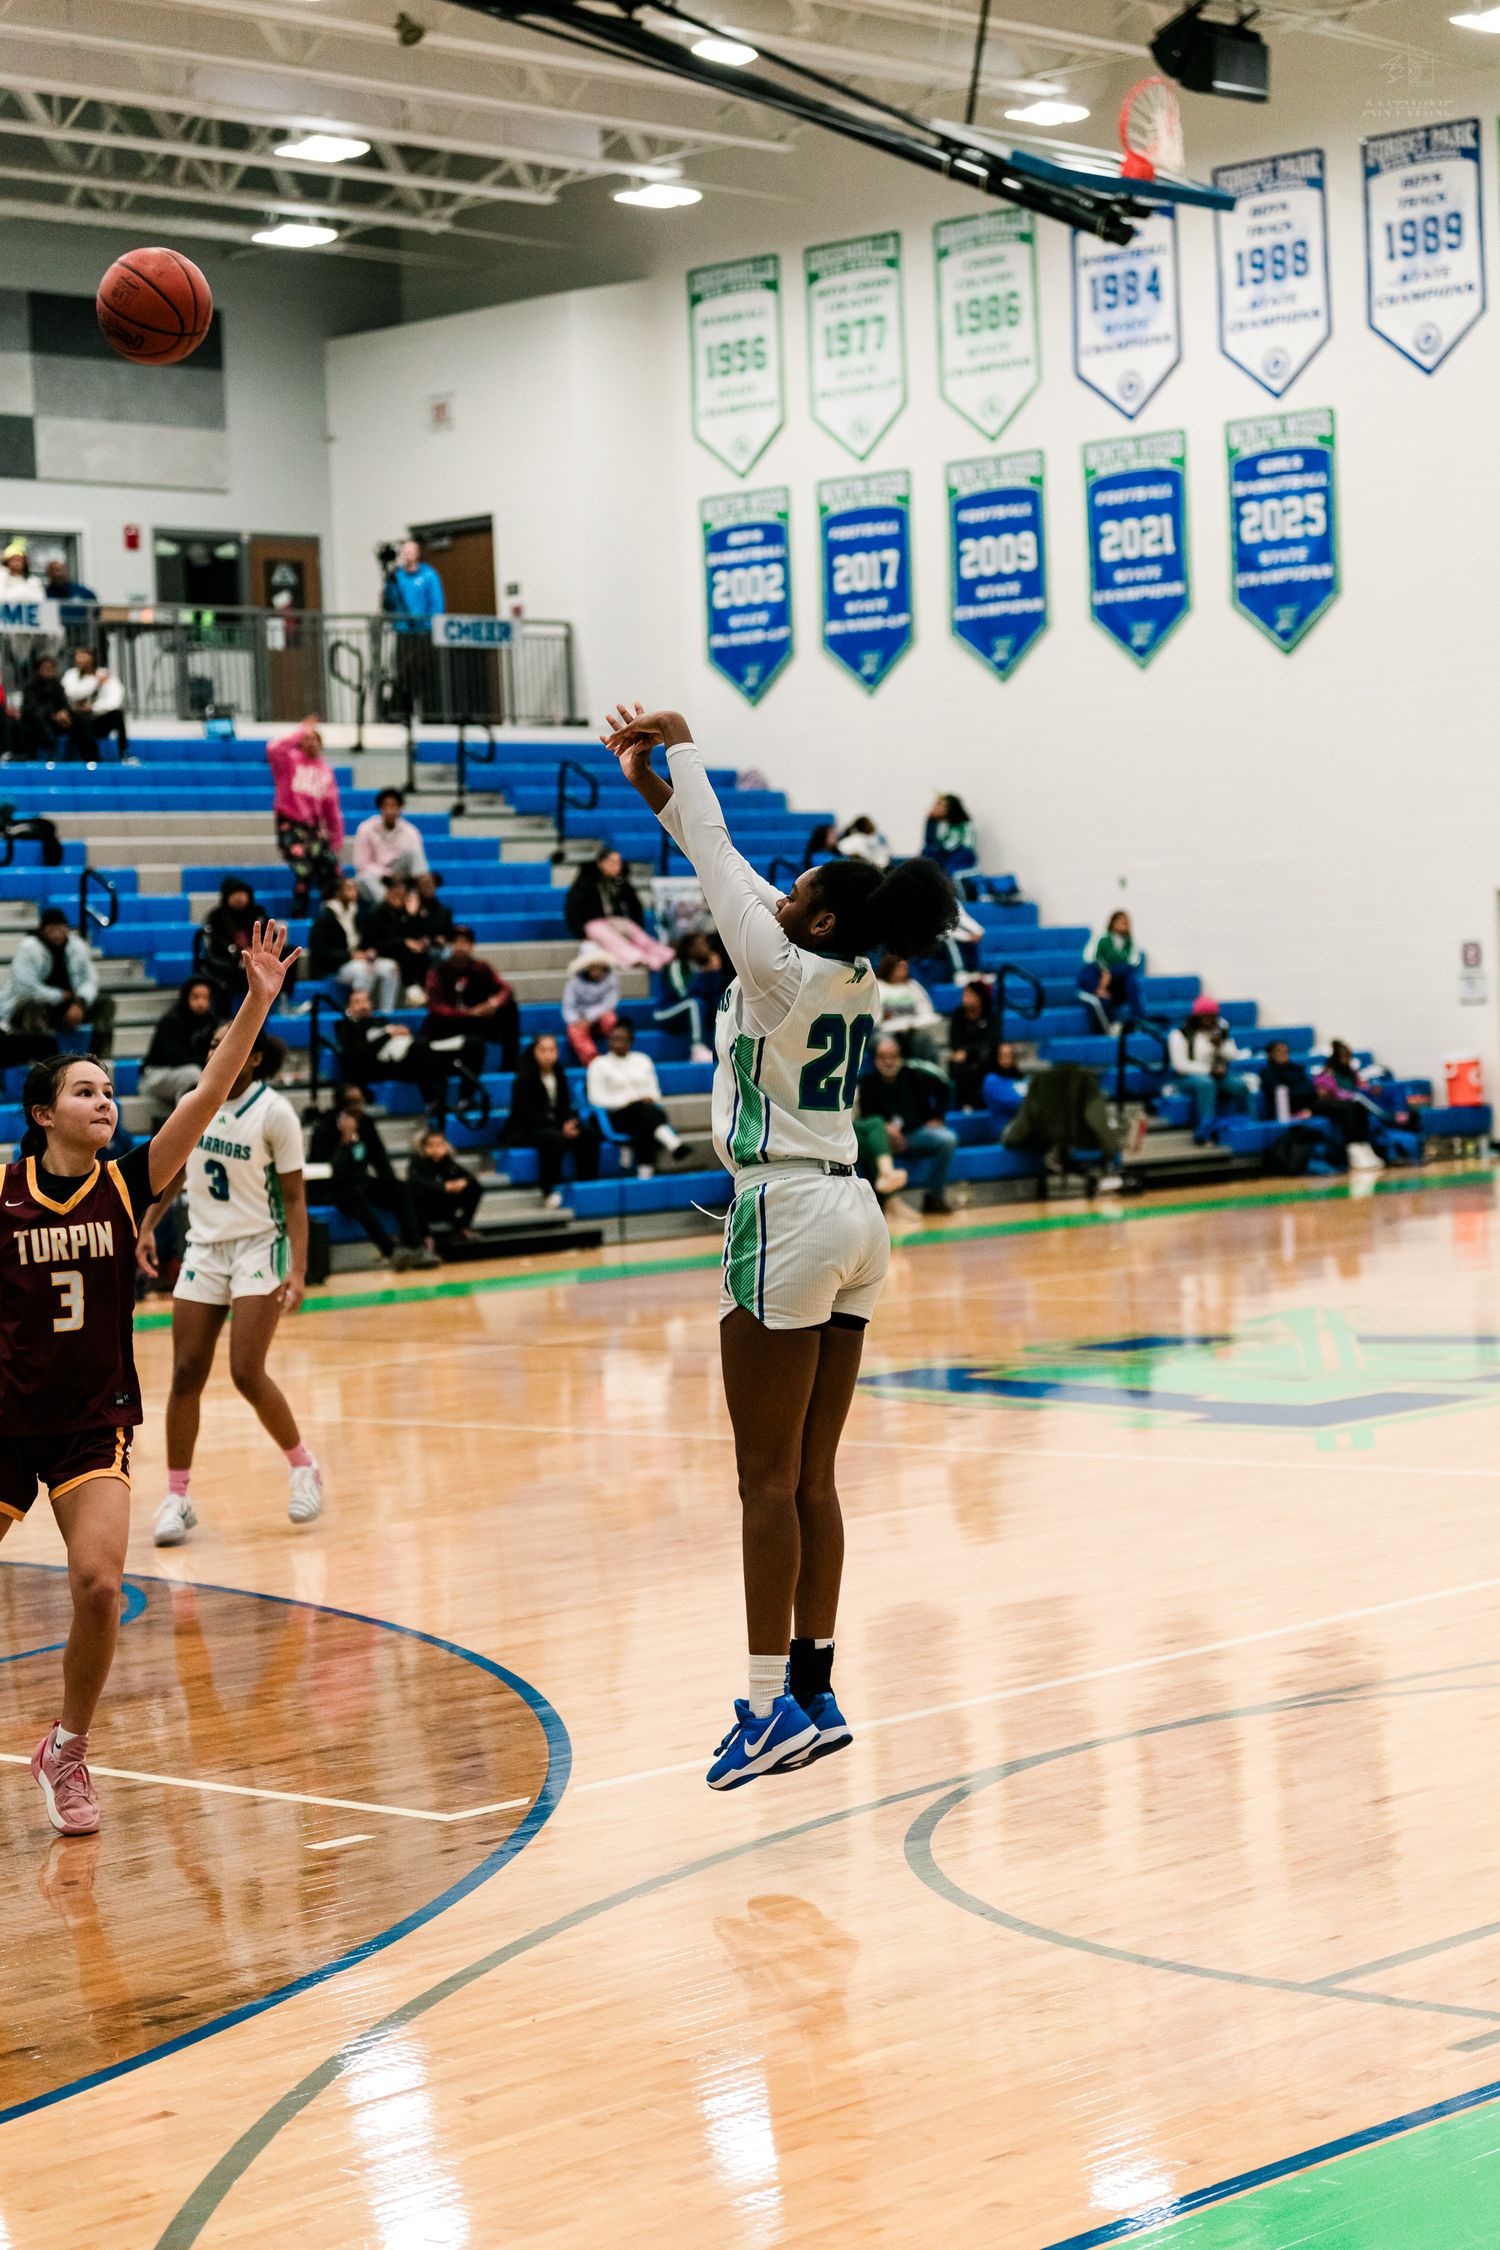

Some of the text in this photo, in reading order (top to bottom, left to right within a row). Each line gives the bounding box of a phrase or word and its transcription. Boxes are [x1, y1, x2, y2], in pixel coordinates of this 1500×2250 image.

[1385, 211, 1464, 262] 1989
[1236, 239, 1309, 288] 1988
[954, 290, 1022, 336] 1986
[1090, 267, 1161, 314] 1984
[823, 315, 886, 359] 1977
[1099, 513, 1176, 563] 2021
[1240, 493, 1327, 544] 2025
[832, 548, 900, 595] 2017
[959, 531, 1038, 580] 2009
[712, 562, 786, 610] 2002
[444, 620, 512, 642] CHEER
[798, 1013, 874, 1111] 20
[197, 1135, 251, 1160] ARRIORS
[204, 1159, 230, 1202] 3
[13, 1221, 114, 1265] TURPIN
[51, 1270, 85, 1333] 3
